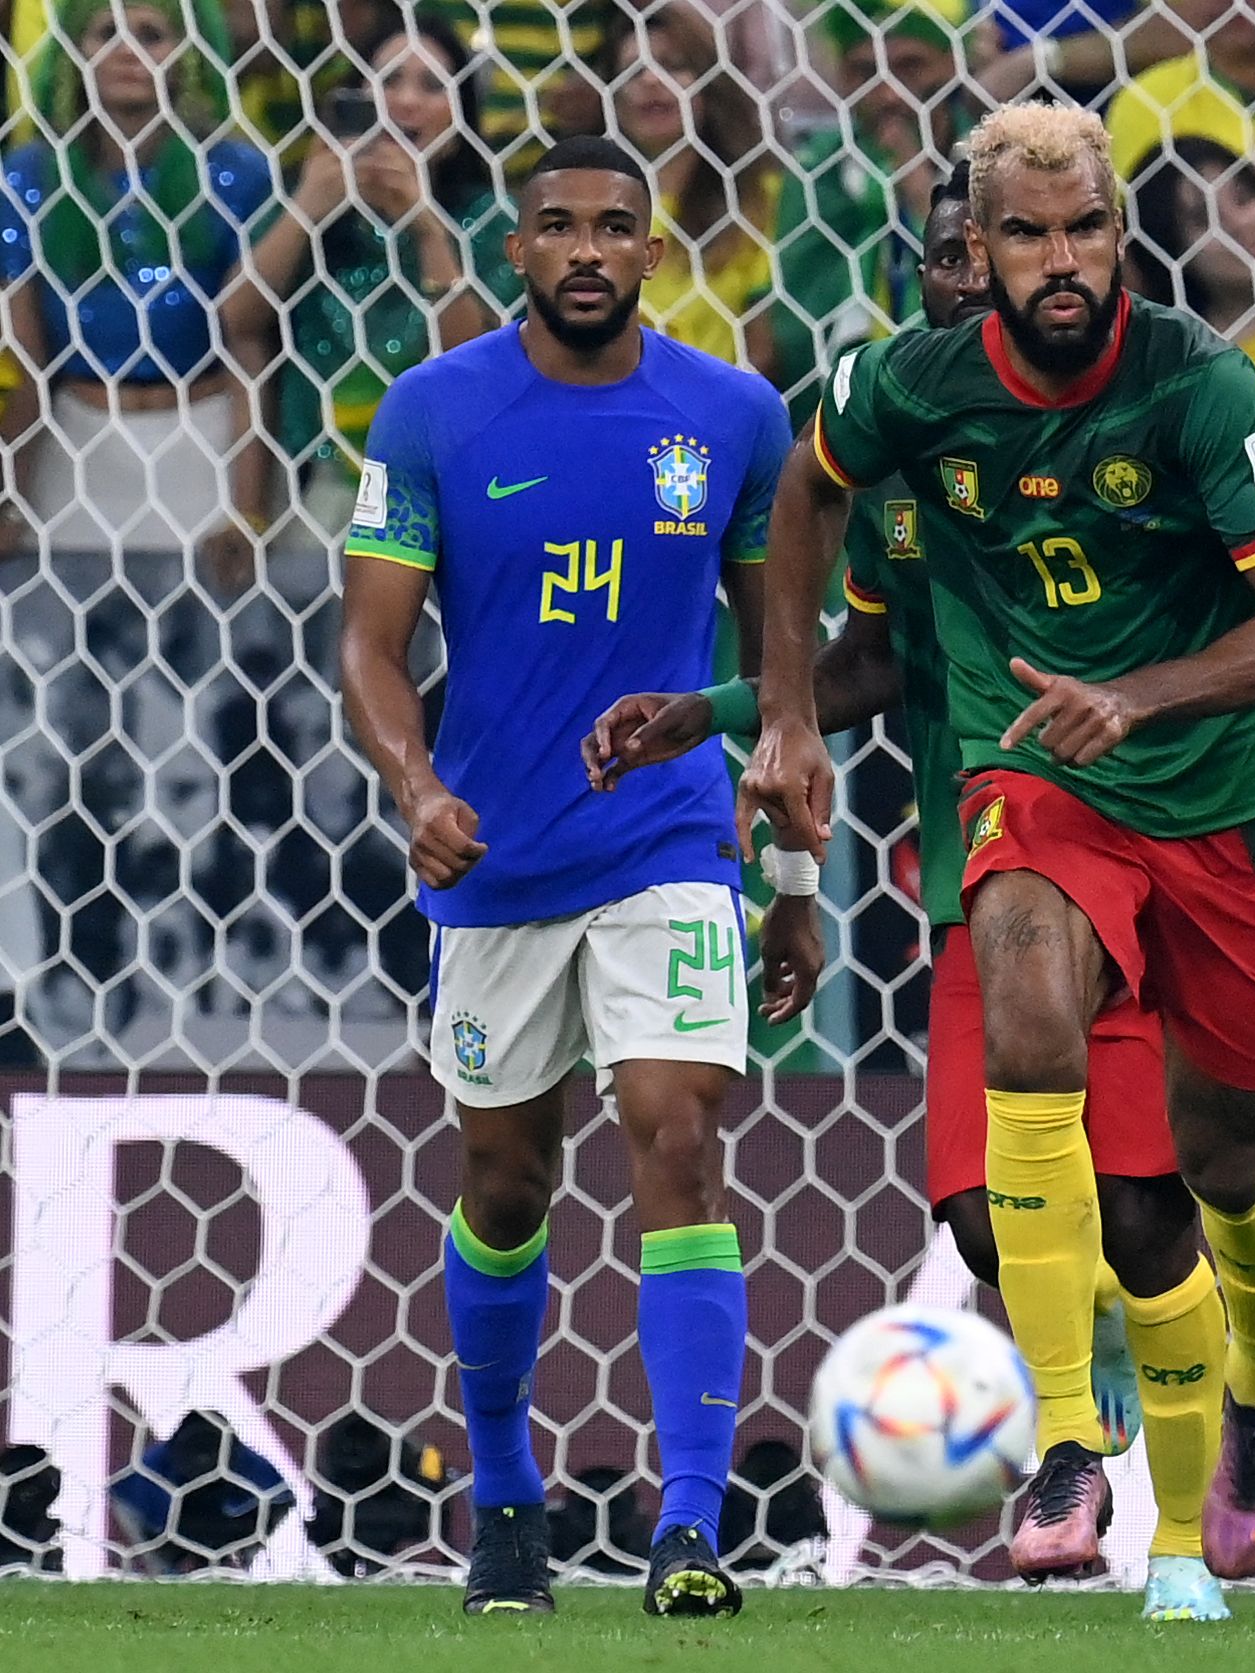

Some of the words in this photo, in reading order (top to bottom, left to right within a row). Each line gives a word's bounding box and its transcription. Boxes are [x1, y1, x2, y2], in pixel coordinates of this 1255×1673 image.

[1019, 475, 1060, 498] one
[654, 520, 708, 537] BRASIL
[540, 538, 624, 623] 24
[1018, 536, 1101, 608] 13
[667, 918, 736, 1006] 24
[457, 1069, 494, 1086] BRASIL
[986, 1188, 1048, 1210] one
[1141, 1363, 1207, 1386] one
